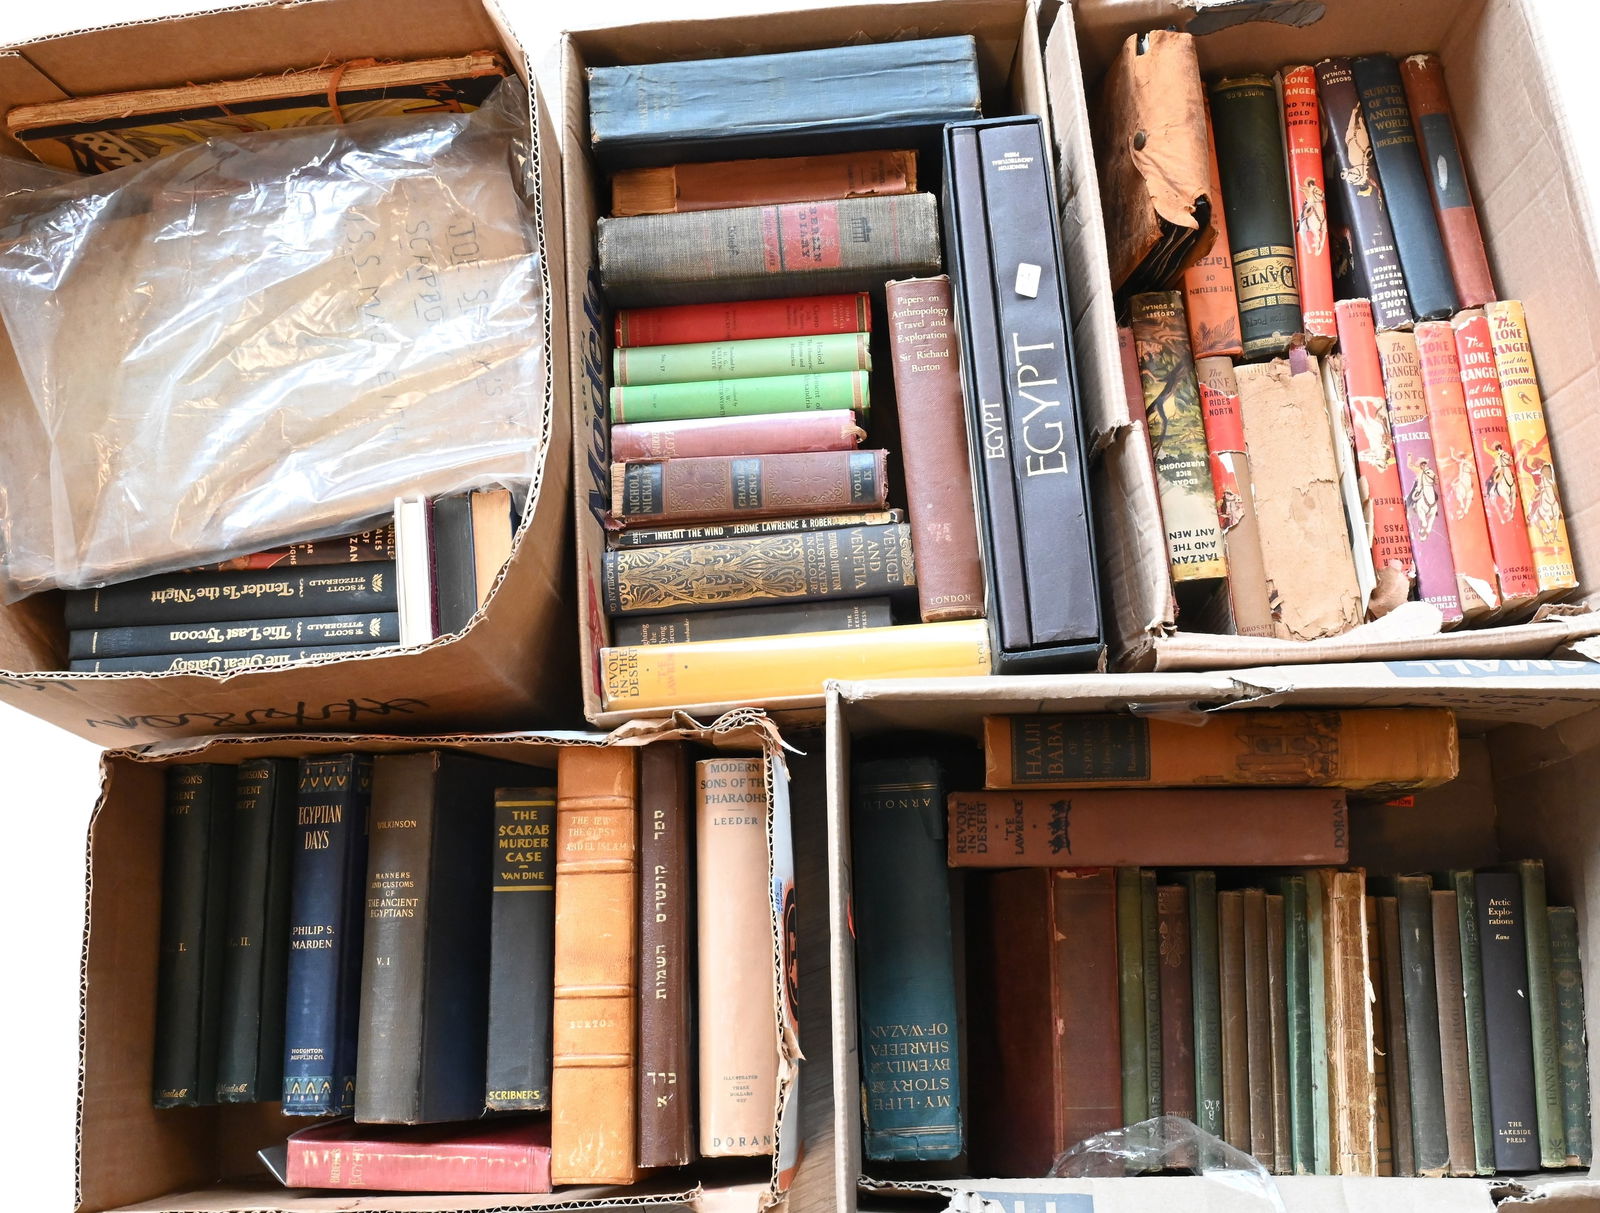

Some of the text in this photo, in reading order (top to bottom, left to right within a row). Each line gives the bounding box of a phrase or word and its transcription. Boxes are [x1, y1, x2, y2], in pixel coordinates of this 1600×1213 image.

[1301, 101, 1316, 110] THE
[1369, 96, 1406, 108] OF THE
[1288, 110, 1310, 120] GOLD
[799, 210, 811, 258] DIARY
[811, 206, 822, 262] BERLIN
[1373, 265, 1397, 275] RANCH
[1205, 275, 1216, 283] OF
[1241, 265, 1297, 291] DANTE
[1190, 286, 1218, 296] RETURN
[1374, 281, 1391, 289] THE
[897, 296, 924, 306] Papers
[1381, 299, 1406, 309] LONE
[892, 306, 948, 319] Anthropology
[1146, 311, 1175, 319] GROSSET
[1387, 309, 1405, 319] THE
[896, 318, 944, 330] Travel and
[1494, 316, 1517, 328] The
[897, 330, 947, 344] Exploration
[1495, 328, 1522, 340] LONE
[1392, 343, 1406, 352] The
[1465, 336, 1484, 348] The
[899, 349, 949, 362] Sir Richard
[1387, 352, 1414, 365] LONE
[1465, 352, 1490, 364] LONE
[911, 364, 940, 372] Burton
[1208, 369, 1222, 378] The
[1387, 365, 1419, 378] RANGER
[1397, 381, 1414, 389] and
[1469, 384, 1496, 395] at the
[1013, 333, 1067, 478] EGYPT
[1209, 398, 1230, 406] RIDES
[1209, 407, 1233, 416] NORTH
[1473, 408, 1502, 419] GULCH
[983, 400, 1004, 459] EGYPT
[1160, 461, 1205, 472] BURROUGHS
[629, 463, 641, 514] NICHOLAS
[1172, 479, 1198, 487] EDGAR
[655, 529, 685, 542] INHERIT
[688, 527, 703, 539] THE
[704, 526, 724, 537] WIND
[734, 523, 760, 535] JEROME
[762, 520, 801, 532] LAWRENCE
[1169, 528, 1215, 541] ANT MEN
[1384, 525, 1404, 533] PASS
[363, 531, 369, 544] OF
[1173, 541, 1216, 552] AND THE
[1381, 547, 1391, 556] OF
[828, 532, 841, 590] EDWARD HUTTON
[850, 528, 866, 589] VENETIA
[867, 540, 880, 571] AND
[884, 528, 899, 583] VENICE
[1171, 553, 1219, 565] TARZAN
[816, 532, 828, 594] ILLUSTRATED
[309, 577, 366, 587] FITZGERALD
[151, 581, 295, 603] Tender Is the Night
[327, 584, 357, 594] SCOTT
[930, 595, 971, 605] LONDON
[307, 621, 365, 632] FITZGERALD
[170, 624, 292, 644] The Last Tycoon
[325, 630, 355, 638] SCOTT
[608, 649, 620, 697] REVOLT
[629, 649, 640, 697] DESERT
[1048, 722, 1064, 776] BABA
[711, 763, 760, 773] MODERN
[701, 778, 746, 790] SONS OF
[705, 793, 767, 805] PHARAOHS
[299, 805, 342, 825] EGYPTIAN
[512, 811, 537, 821] THE
[572, 816, 590, 825] THE
[376, 820, 417, 831] WILKINSON
[714, 817, 759, 826] LEEDER
[1334, 798, 1344, 850] DORAN
[499, 825, 550, 837] SCARAB
[569, 828, 586, 837] THE
[956, 802, 968, 854] REVOLT
[977, 802, 988, 854] DESERT
[1014, 802, 1025, 854] LAWRENCE
[305, 831, 330, 850] DAYS
[500, 838, 549, 849] MURDER
[506, 852, 543, 863] CASE
[375, 872, 410, 882] MANNERS
[523, 872, 544, 880] DINE
[382, 881, 415, 890] CUSTOMS
[385, 890, 396, 898] OF
[381, 899, 418, 908] ANCIENT
[1489, 898, 1511, 907] Arctic
[371, 908, 414, 918] EGYPTIANS
[1488, 907, 1513, 920] Explo-
[293, 924, 335, 936] PHILIP S.
[292, 939, 333, 951] MARDEN
[927, 1023, 949, 1036] OF
[870, 1041, 949, 1056] SHAREEFA
[887, 1058, 951, 1073] BY EMILY
[893, 1078, 949, 1092] STORY
[489, 1090, 540, 1101] SCRIBNERS
[874, 1095, 951, 1112] MY LIFE
[1499, 1129, 1532, 1137] LAKESIDE
[713, 1134, 772, 1149] DORAN
[1506, 1136, 1527, 1145] PRESS
